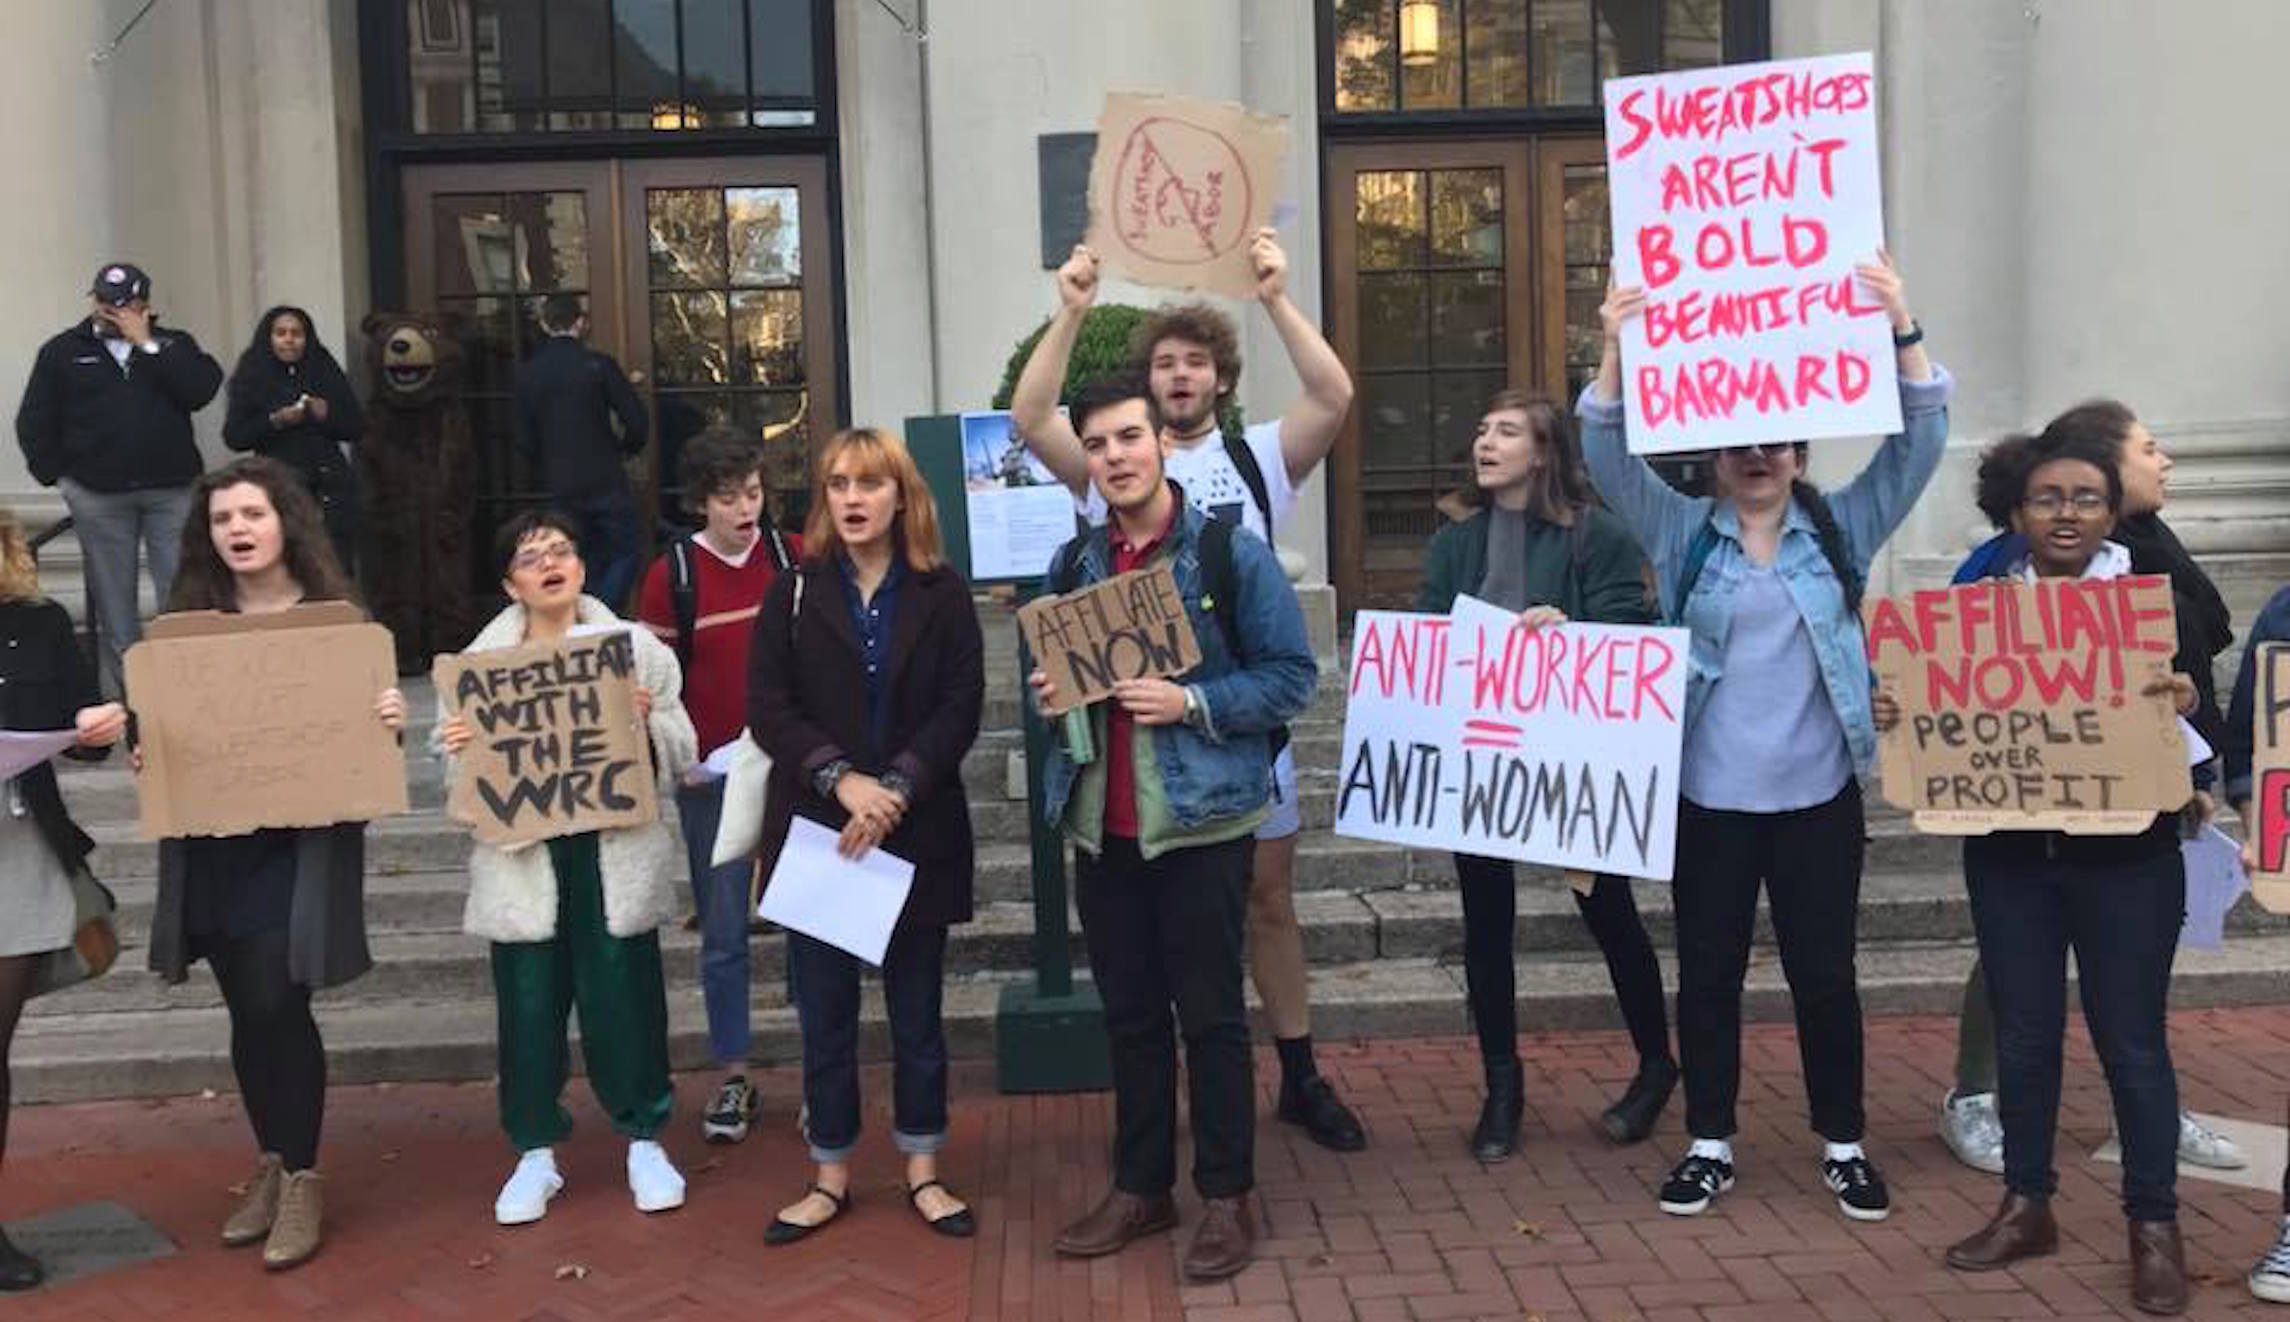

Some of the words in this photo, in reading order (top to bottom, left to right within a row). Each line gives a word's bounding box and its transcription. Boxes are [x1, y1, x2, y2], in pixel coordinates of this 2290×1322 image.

[1616, 72, 1871, 160] SWEATSHOPS
[1660, 132, 1847, 213] AREN'T
[1637, 213, 1827, 289] BOLD
[1643, 275, 1886, 349] BEAUTIFUL
[1637, 349, 1871, 430] BARNARD
[1866, 575, 2174, 662] AFFILIATE
[1067, 622, 1184, 698] NOW
[1351, 618, 1678, 724] ANTI-WORKER
[1926, 640, 2126, 715] NOW!
[475, 684, 601, 735] WITH
[490, 727, 609, 778] THE
[1969, 745, 2044, 773] OVER
[475, 759, 639, 829] WRC
[1337, 737, 1660, 868] ANTI-WOMAN
[1925, 772, 2125, 811] PROFIT
